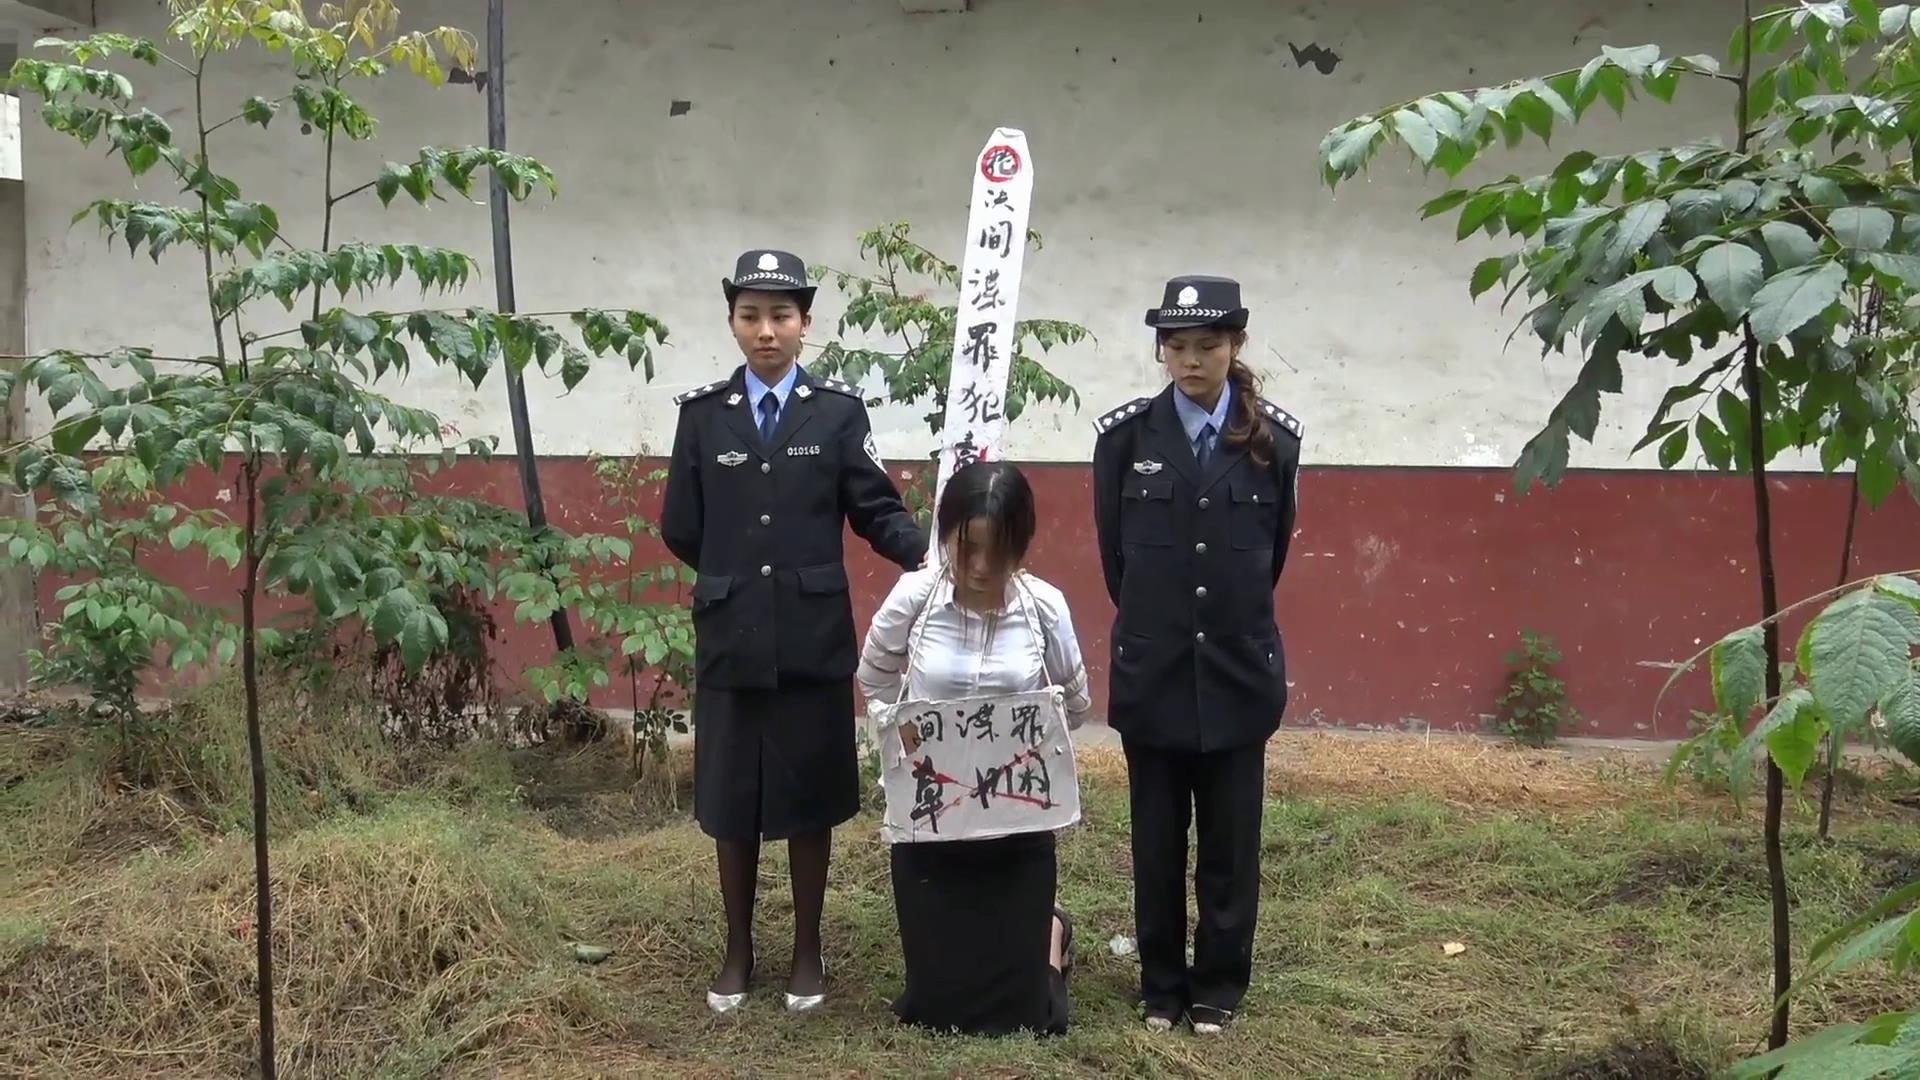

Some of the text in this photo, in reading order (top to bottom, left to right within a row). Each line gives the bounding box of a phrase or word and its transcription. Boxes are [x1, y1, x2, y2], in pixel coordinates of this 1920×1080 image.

[787, 445, 820, 456] 010145
[914, 703, 1045, 748] 间谍罪
